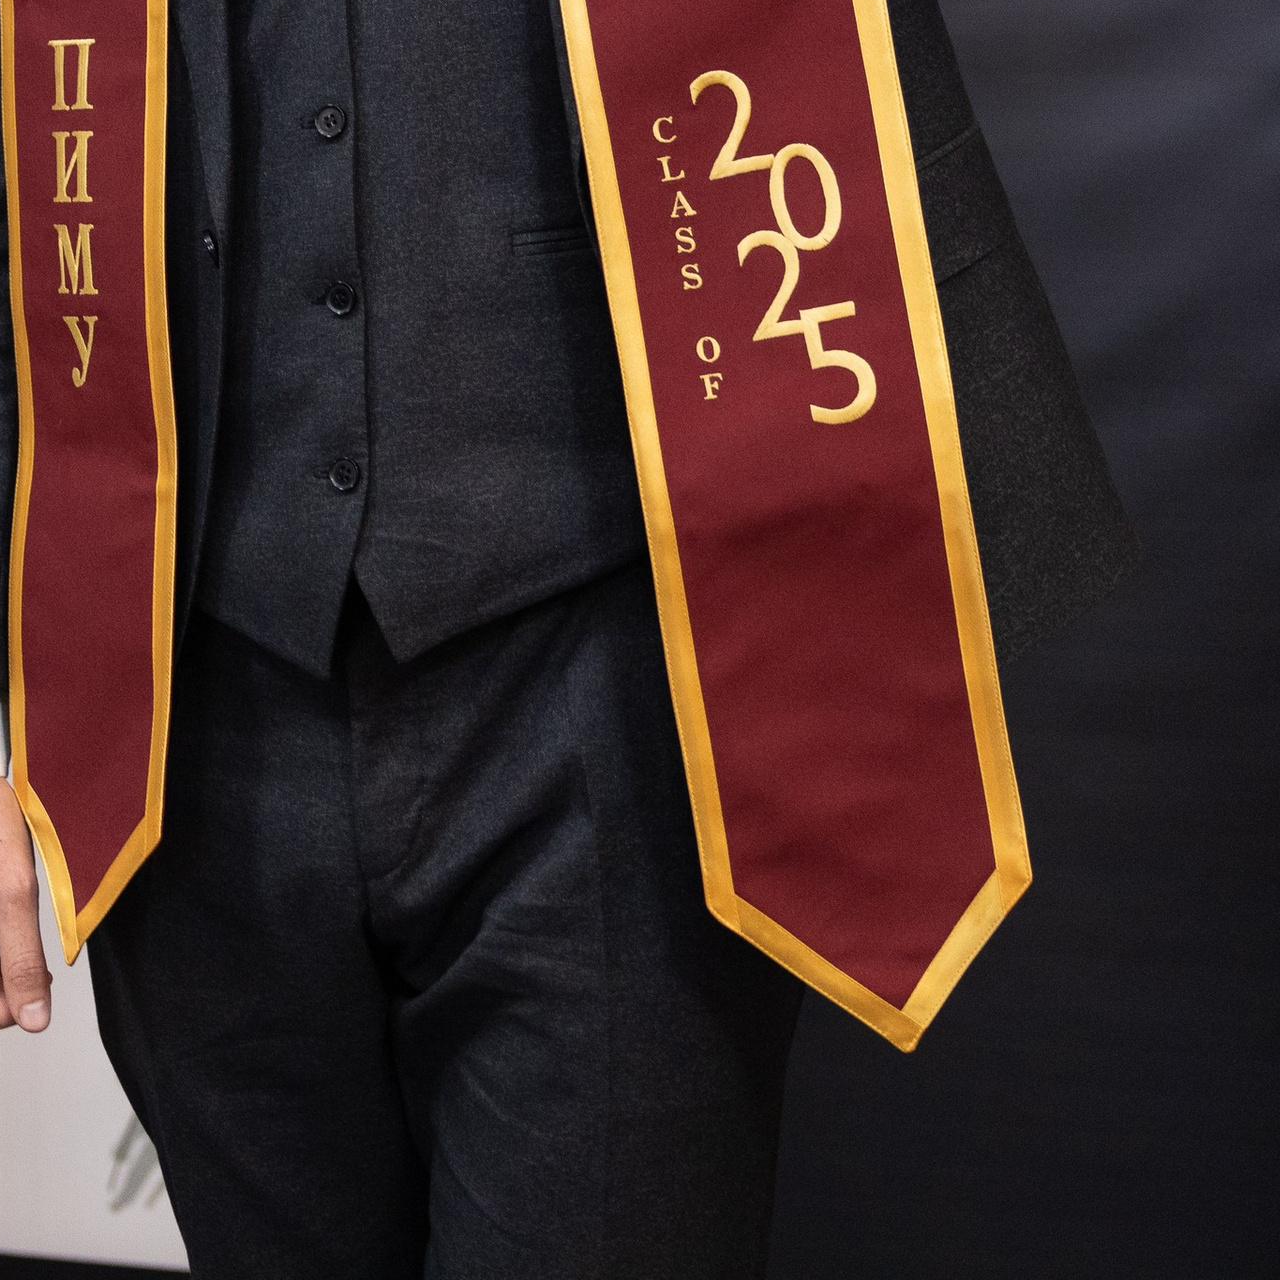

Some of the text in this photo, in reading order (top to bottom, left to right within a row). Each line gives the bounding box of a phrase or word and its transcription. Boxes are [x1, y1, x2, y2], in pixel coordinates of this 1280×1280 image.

[652, 115, 723, 401] CLASS OF
[689, 69, 877, 425] 2025
